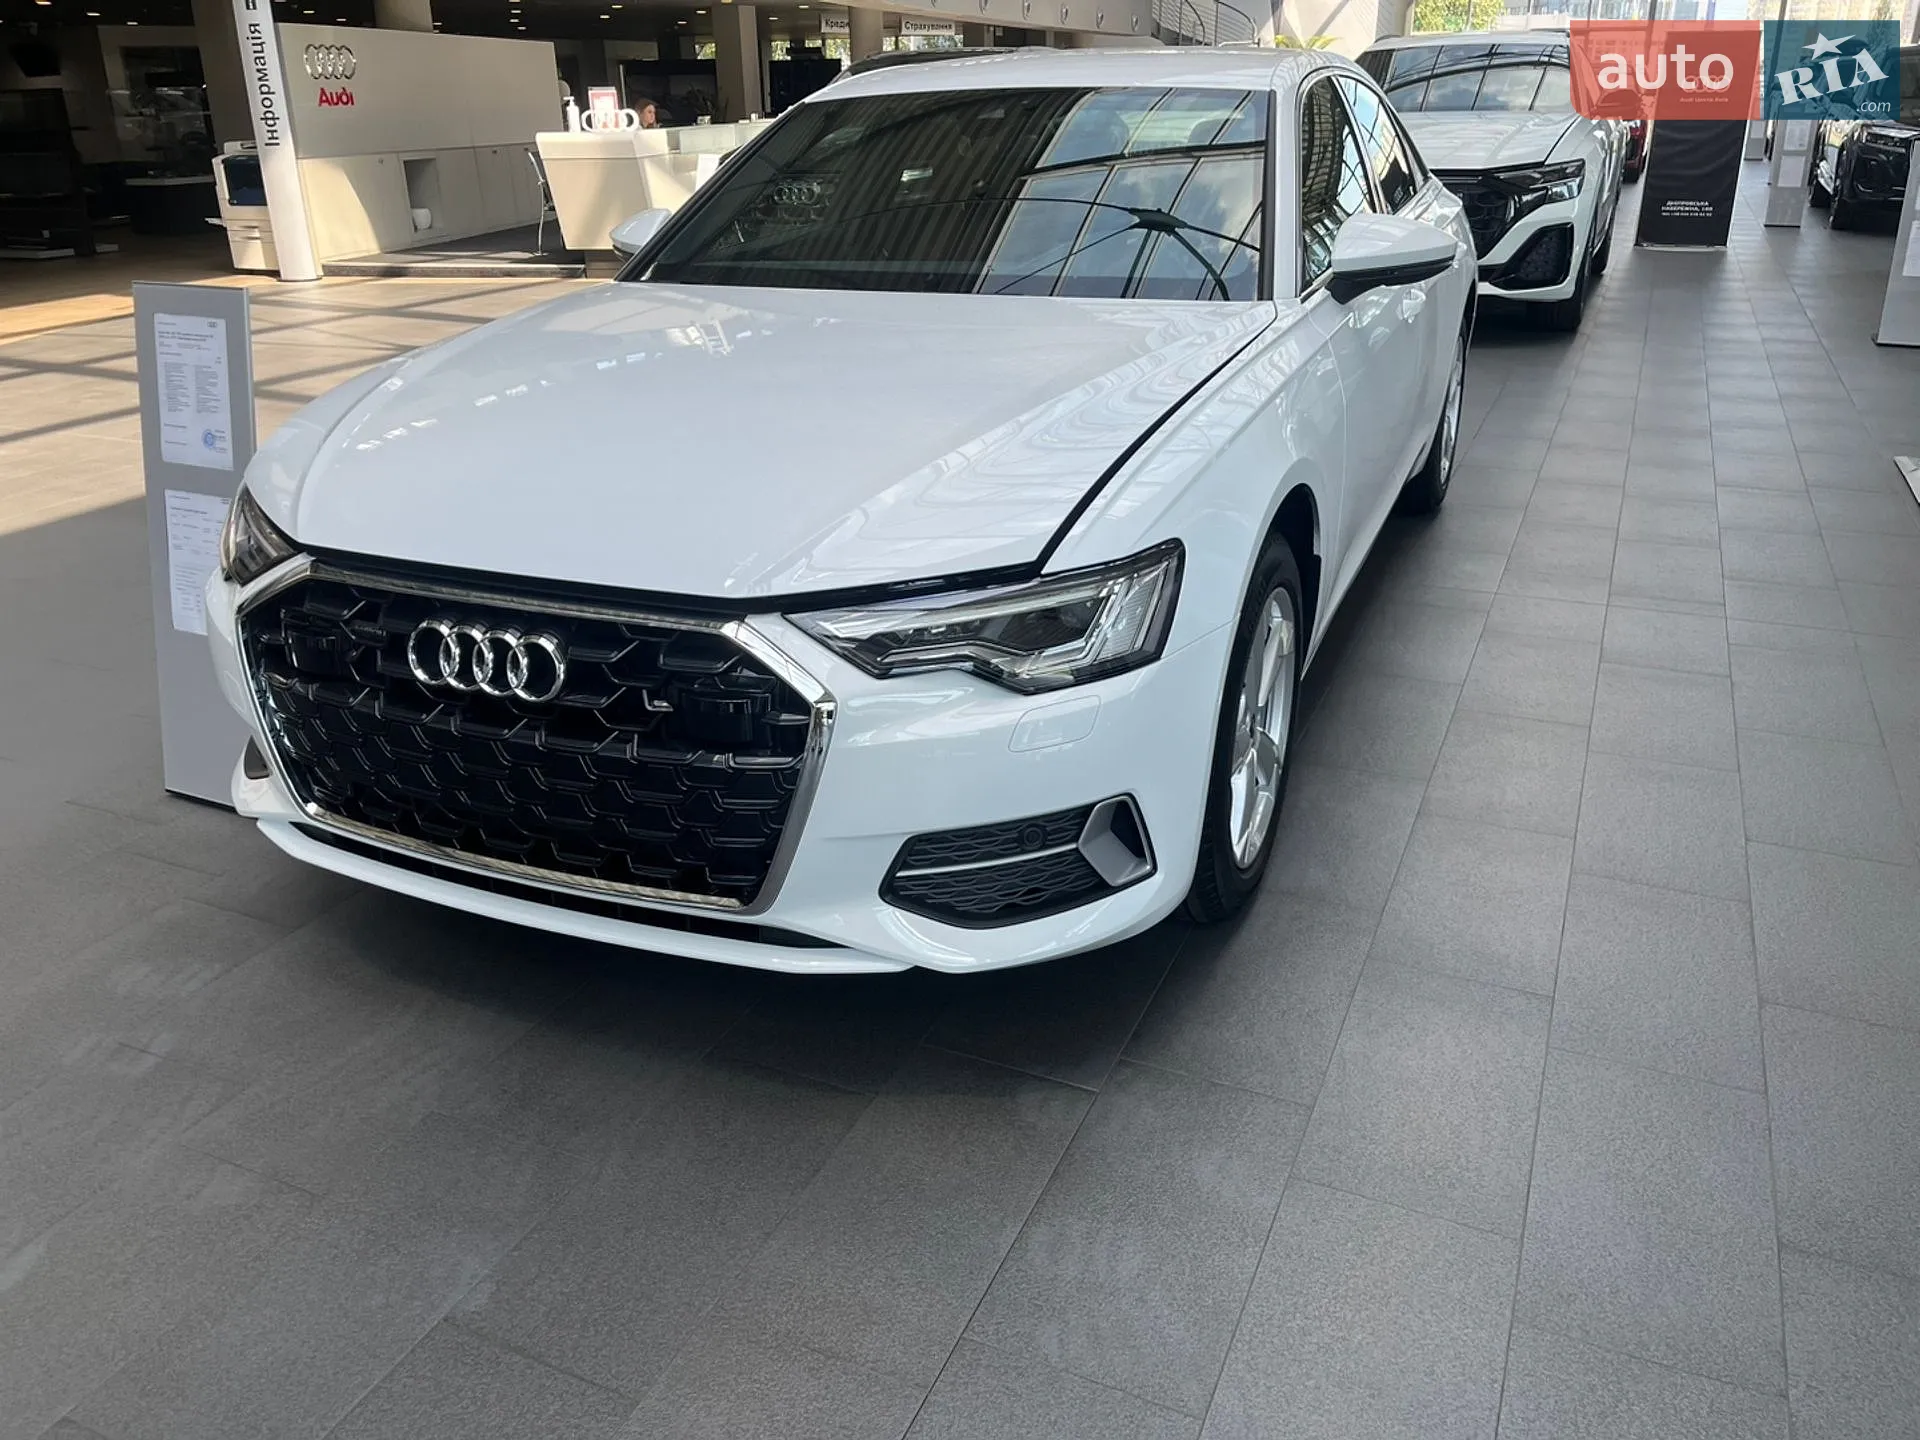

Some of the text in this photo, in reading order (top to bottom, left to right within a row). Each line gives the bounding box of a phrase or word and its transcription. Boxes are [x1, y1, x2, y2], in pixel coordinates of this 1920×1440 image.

[825, 18, 850, 29] Креди
[904, 21, 953, 32] Страхування
[246, 23, 280, 146] Інформація
[318, 87, 355, 107] Audi
